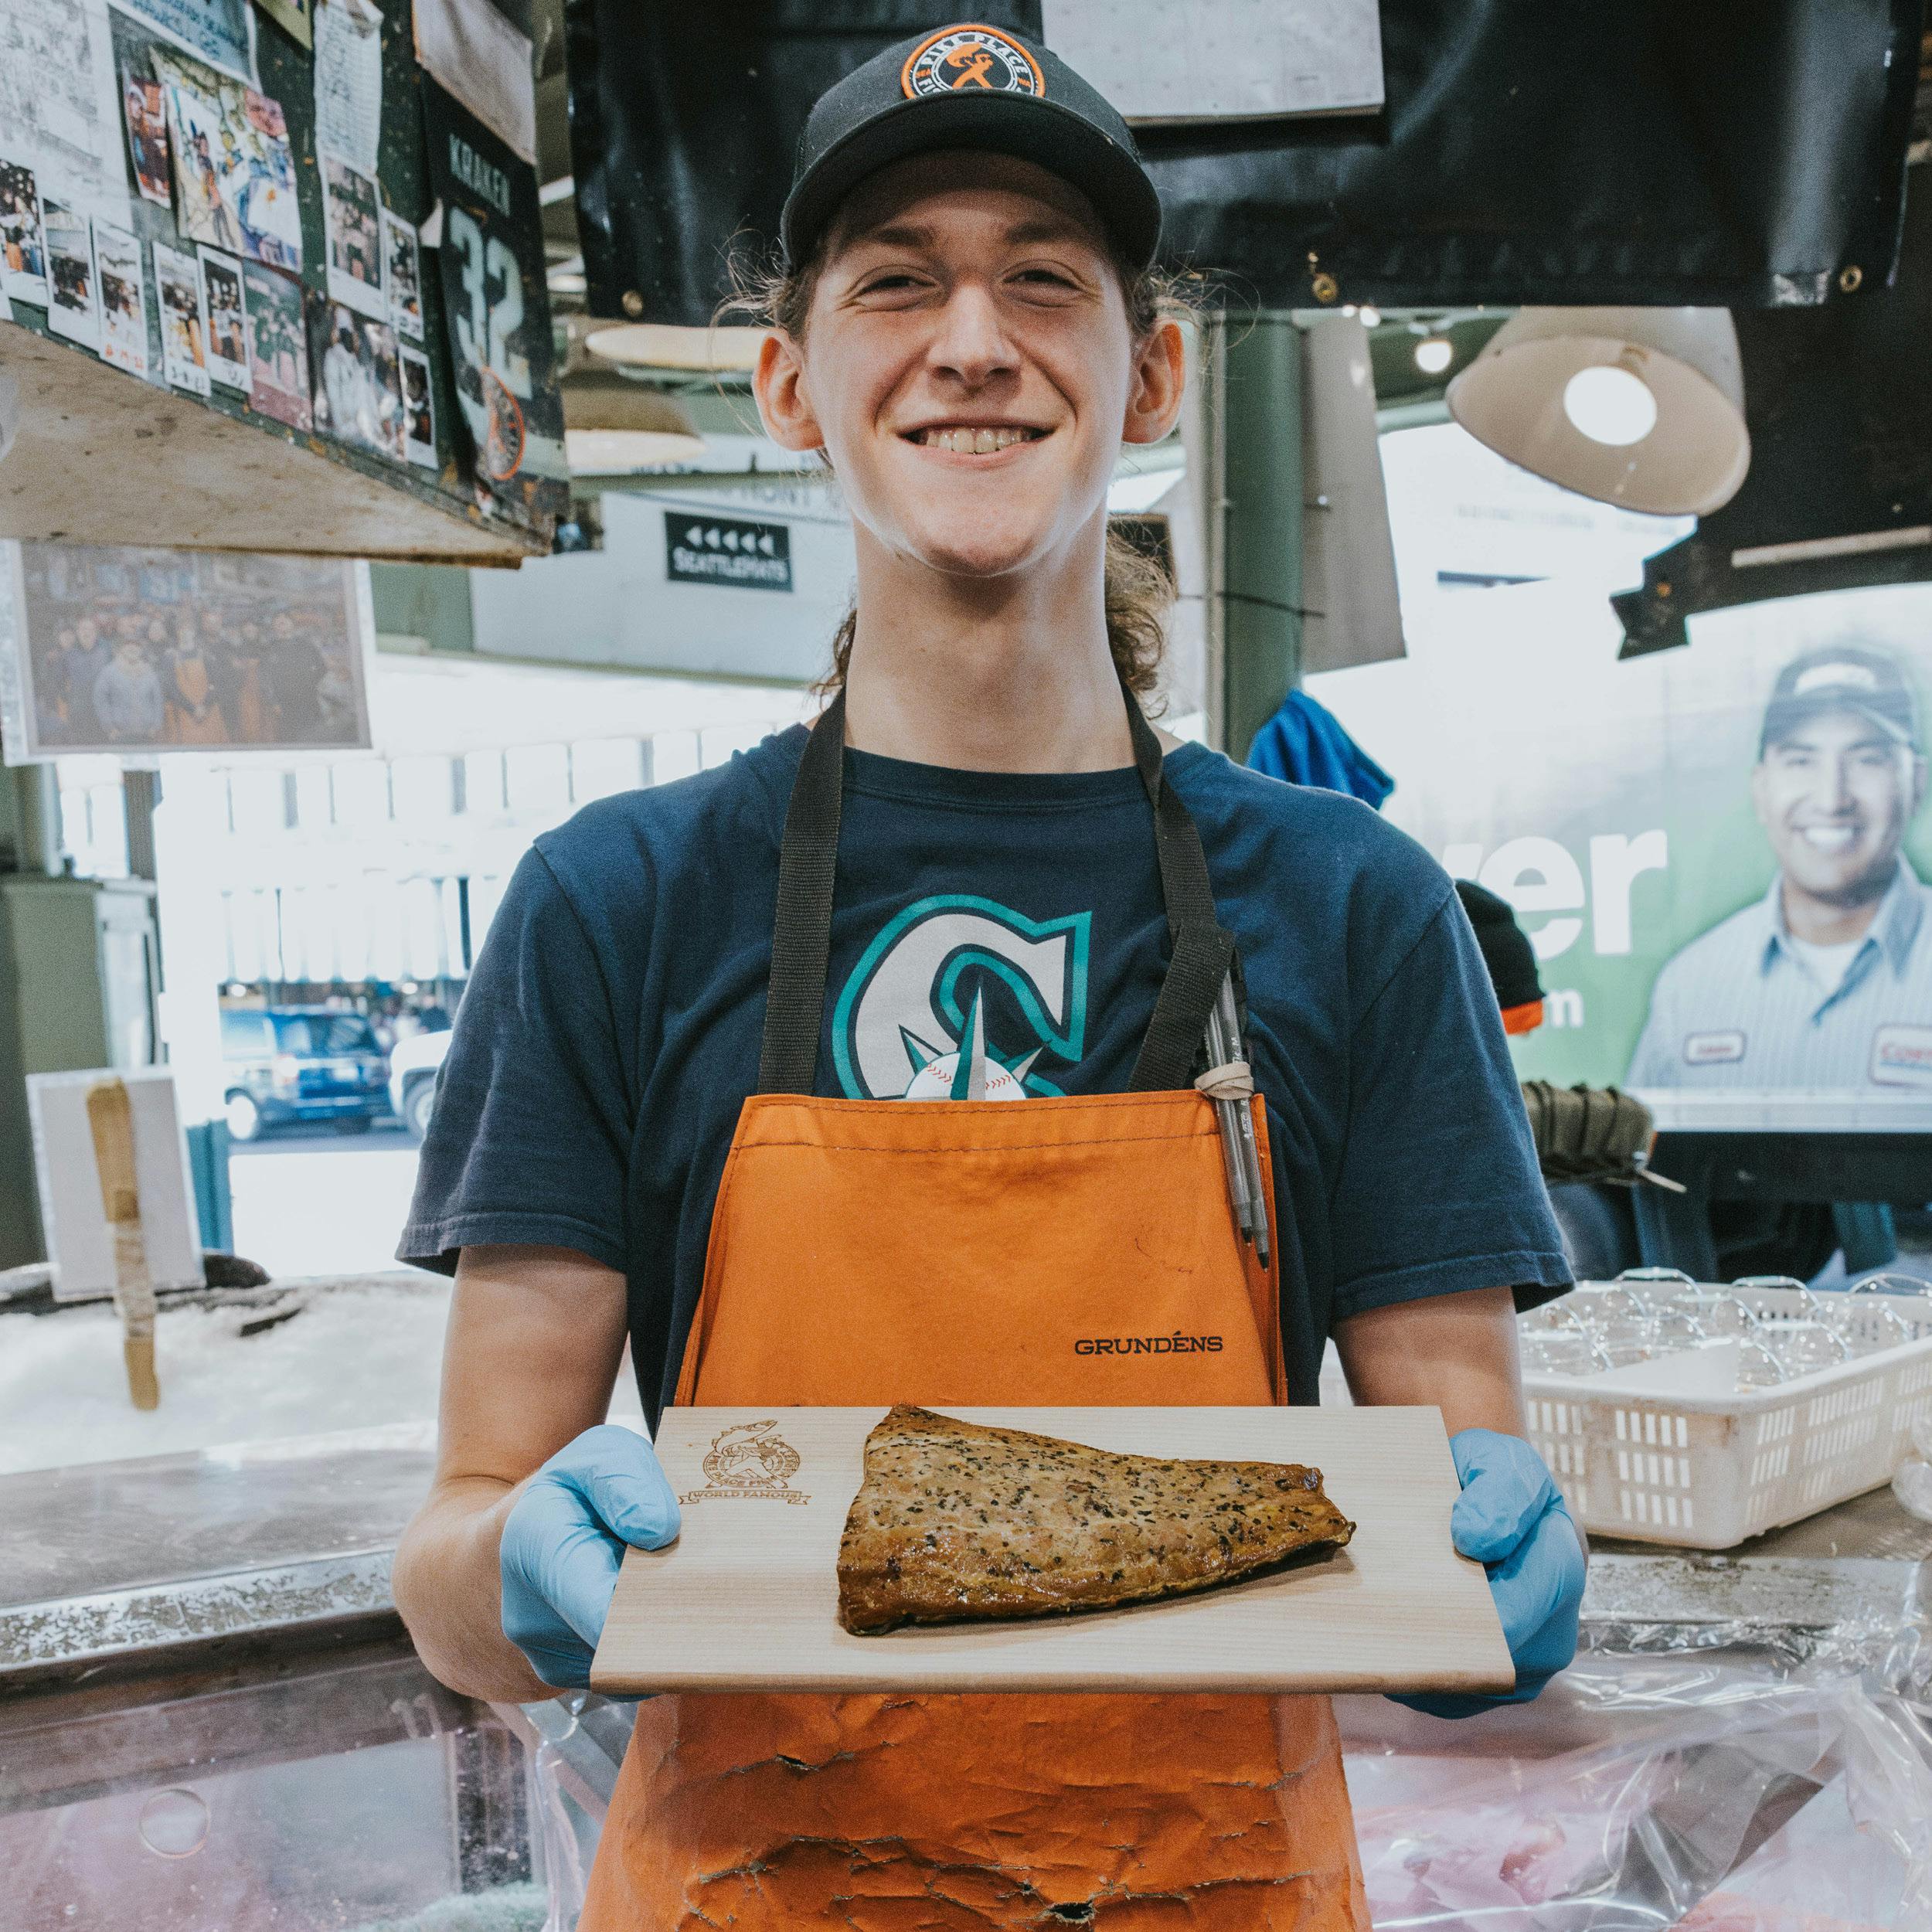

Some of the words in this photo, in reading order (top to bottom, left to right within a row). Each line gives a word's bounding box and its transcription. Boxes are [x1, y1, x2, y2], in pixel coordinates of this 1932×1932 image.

[920, 36, 962, 66] PIKE
[975, 34, 1029, 74] PLACE
[447, 206, 532, 400] 32
[1074, 1330, 1223, 1355] GRUNDÉNS
